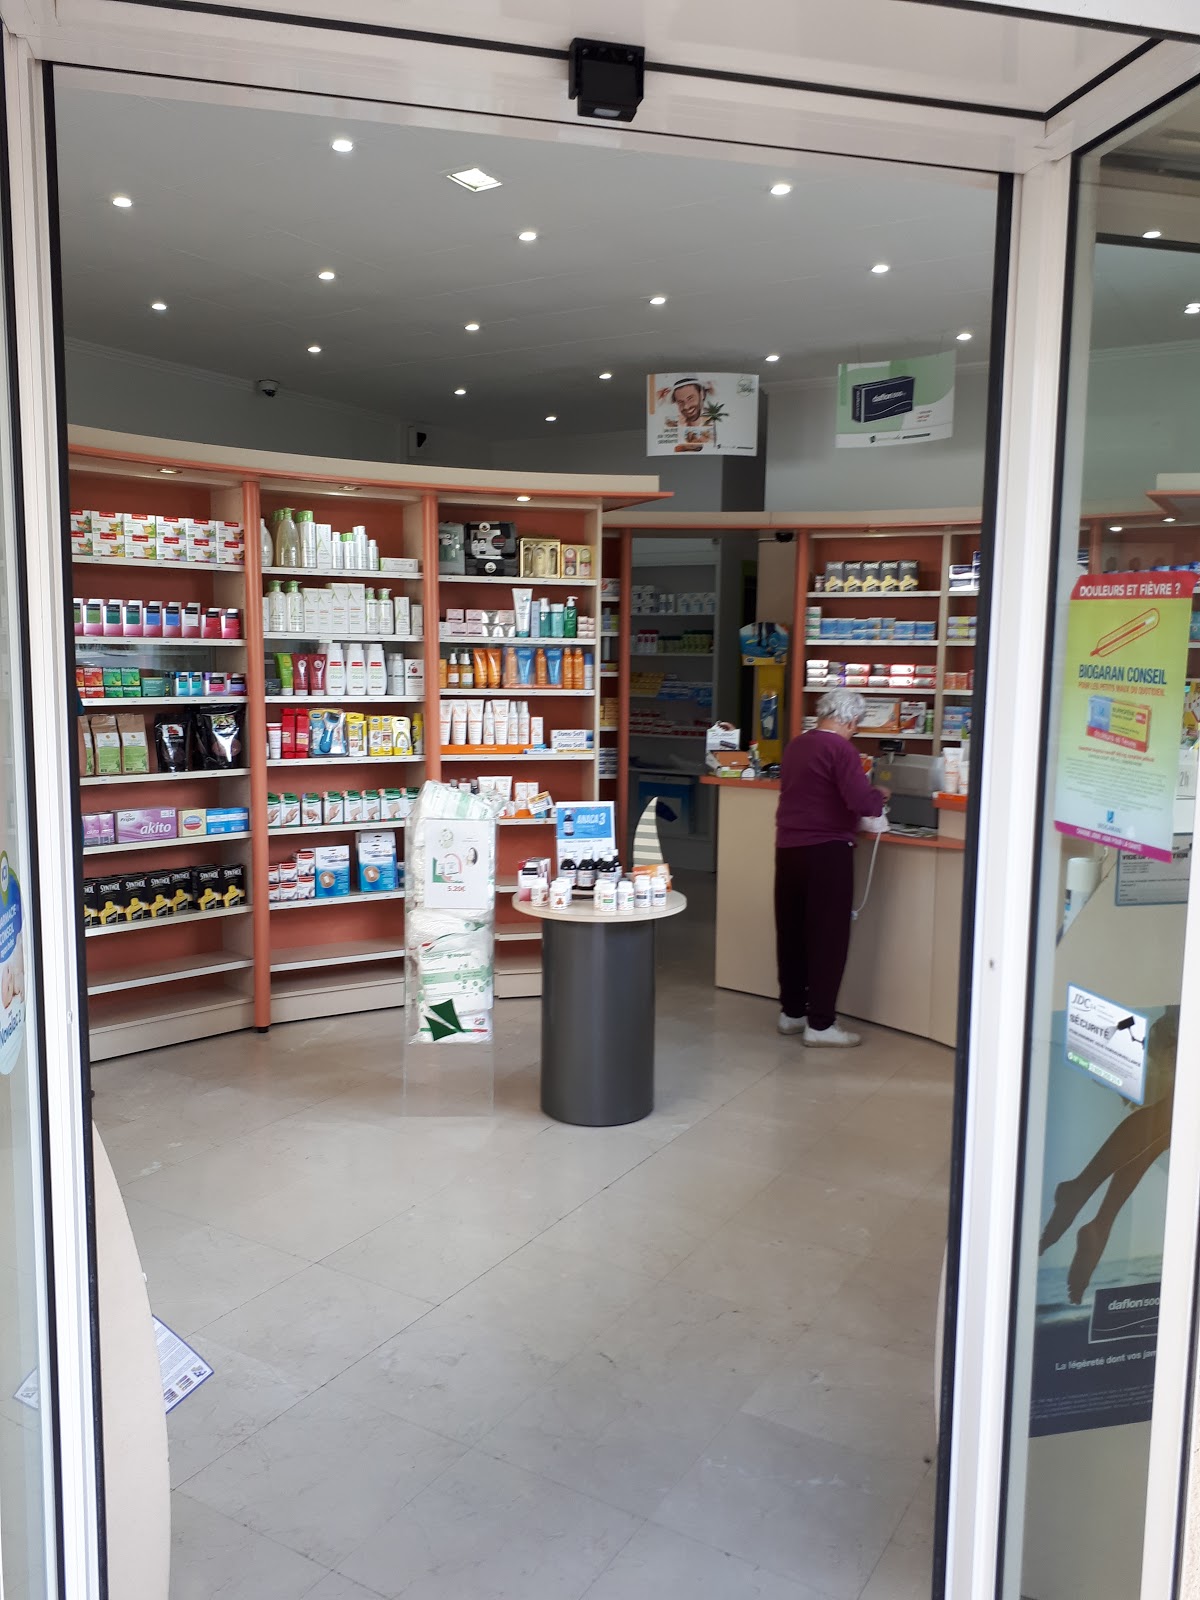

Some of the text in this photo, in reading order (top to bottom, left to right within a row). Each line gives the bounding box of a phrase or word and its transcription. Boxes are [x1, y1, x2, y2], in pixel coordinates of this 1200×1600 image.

[1079, 580, 1182, 597] DOULEURS ET FIÈVRE ?
[1078, 664, 1167, 685] BIOGARAN CONSEIL
[140, 821, 172, 835] akito
[150, 875, 171, 887] SYNTHOL
[199, 870, 219, 881] SYNTHOL
[99, 882, 120, 893] SYNTHOL
[125, 878, 146, 890] SYNTHOL
[1072, 993, 1091, 1009] JDC
[1069, 1013, 1110, 1039] SÉCURITÉ
[1055, 1362, 1067, 1371] La
[1068, 1357, 1105, 1369] légèreté
[1106, 1353, 1126, 1365] dont
[1126, 1351, 1142, 1361] vos
